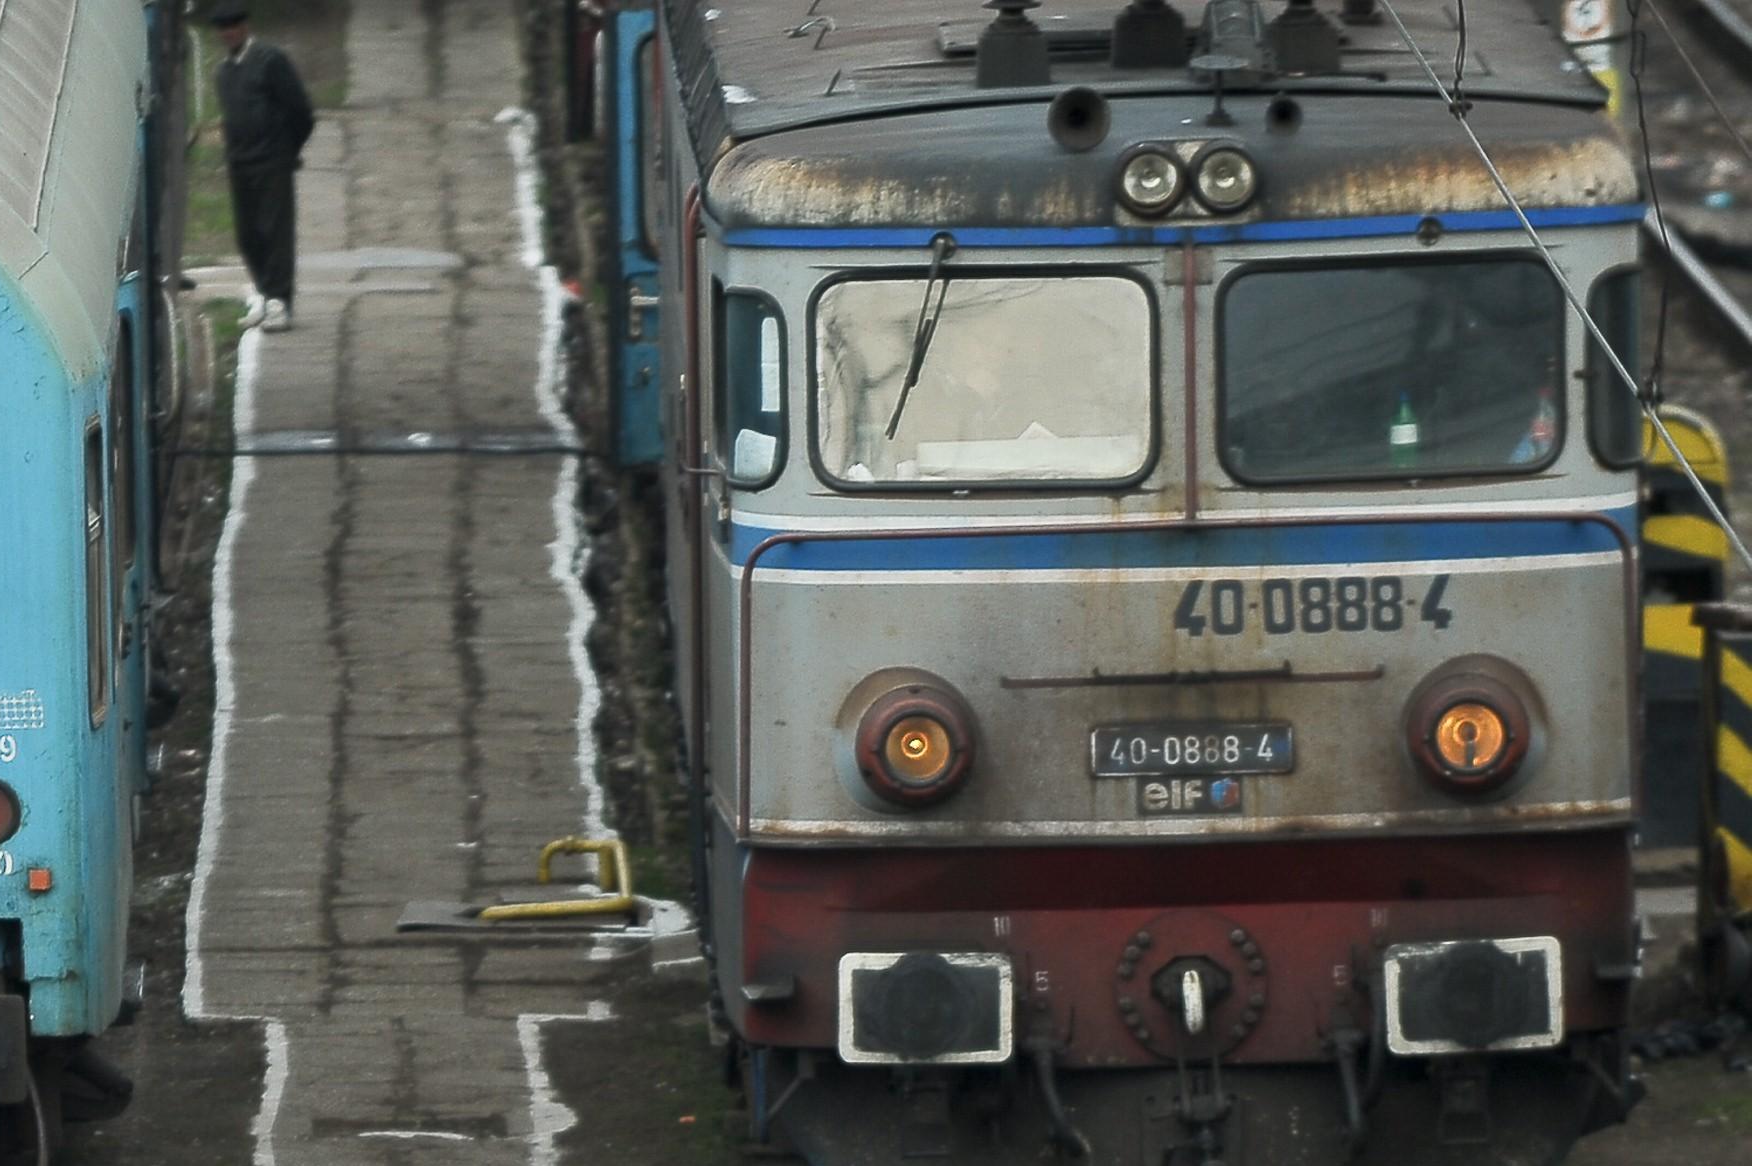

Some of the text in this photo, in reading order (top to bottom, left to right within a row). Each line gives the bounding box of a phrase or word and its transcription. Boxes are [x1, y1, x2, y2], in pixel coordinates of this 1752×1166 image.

[1173, 574, 1454, 637] 40-0888-4
[1110, 732, 1273, 765] 40-0888-4
[1143, 780, 1202, 810] elf
[1035, 970, 1049, 992] 5
